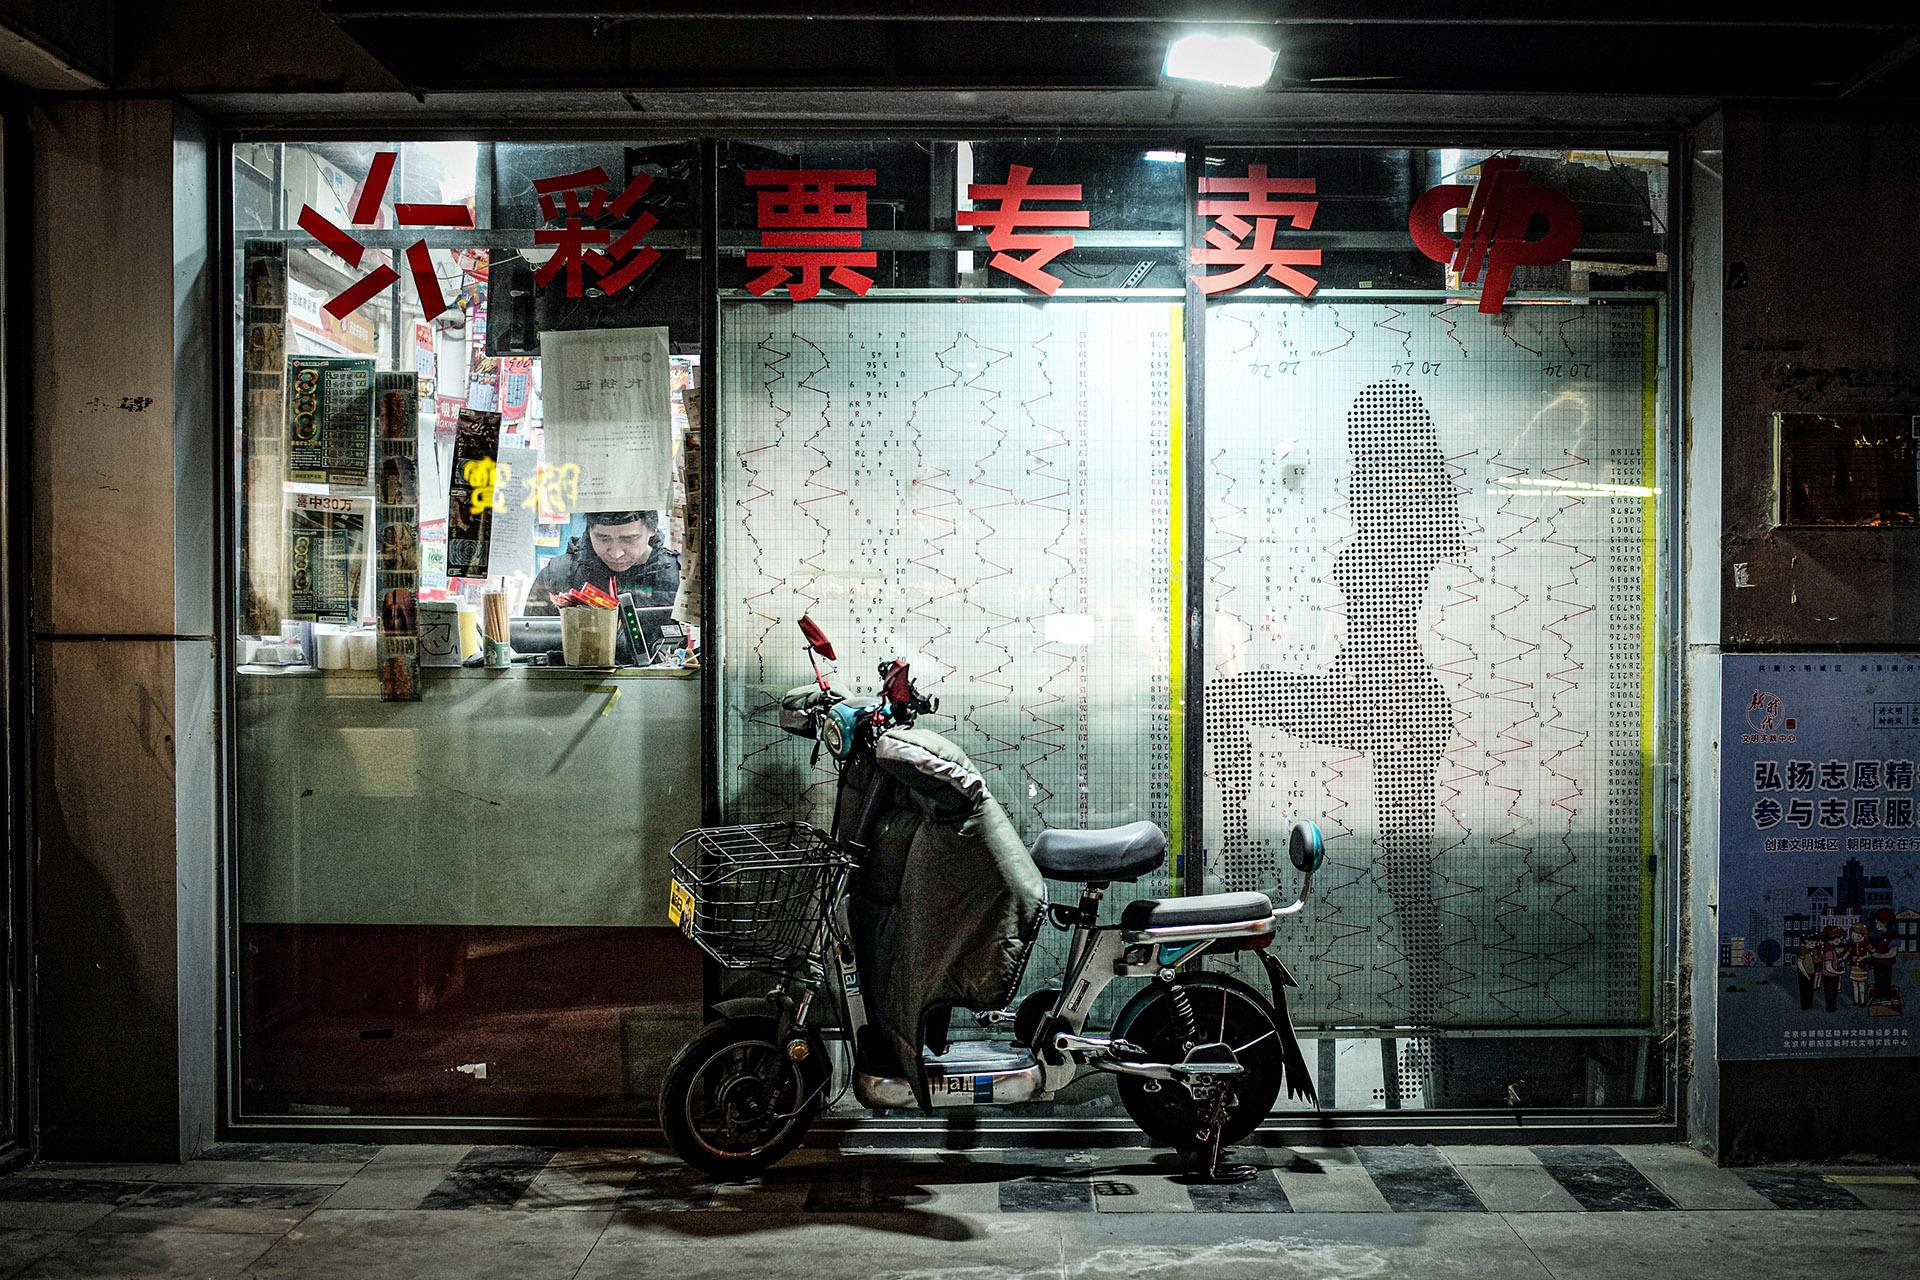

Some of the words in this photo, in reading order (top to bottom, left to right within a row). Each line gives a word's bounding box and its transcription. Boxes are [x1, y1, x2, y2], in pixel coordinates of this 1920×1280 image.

[532, 164, 1322, 302] 彩票专卖
[296, 494, 353, 511] 喜中30万
[1741, 734, 1797, 743] 文明实践中心
[1754, 761, 1920, 791] 弘扬志愿精
[1753, 798, 1920, 829] 参与志愿服
[1764, 838, 1839, 852] 创建文明城区
